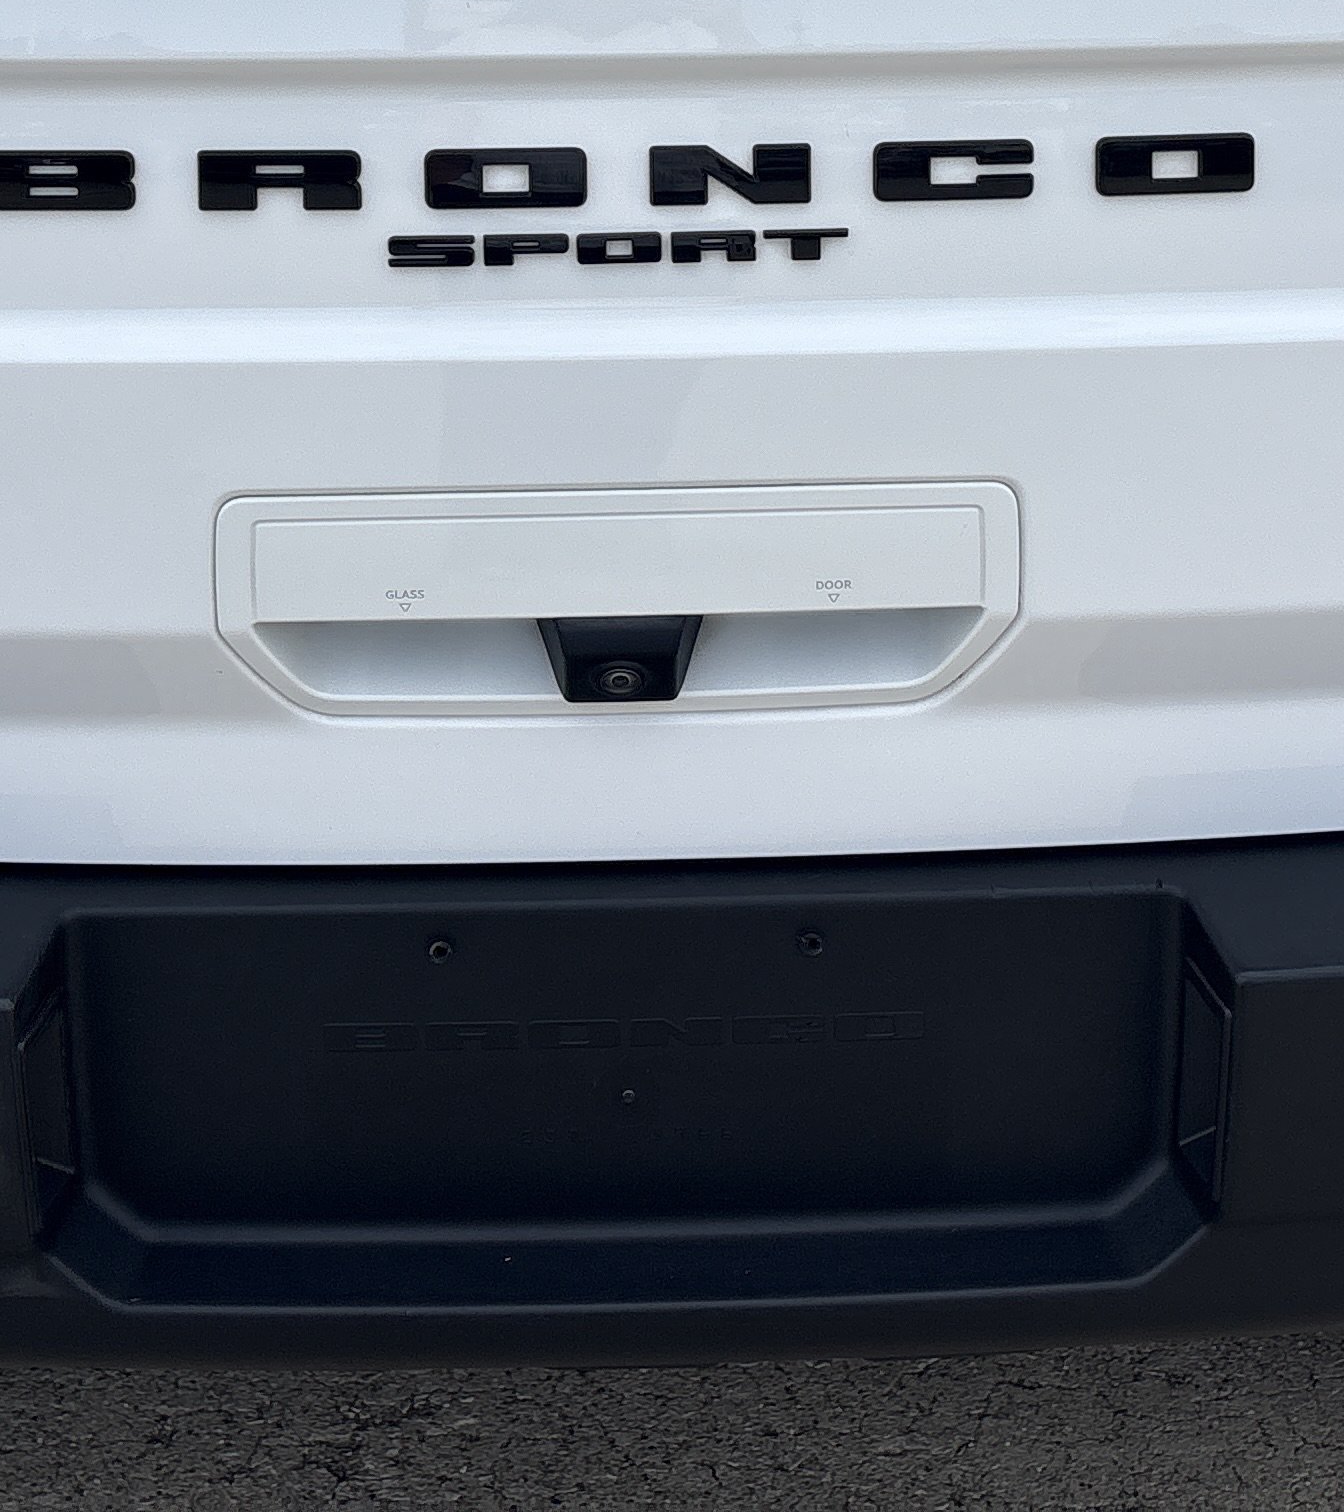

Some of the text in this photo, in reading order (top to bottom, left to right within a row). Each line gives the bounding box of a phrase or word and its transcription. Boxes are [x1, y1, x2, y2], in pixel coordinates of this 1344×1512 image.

[387, 227, 849, 267] SPORT
[385, 589, 425, 600] GLASS
[815, 579, 852, 590] DOOR
[322, 1011, 924, 1053] BRONCO
